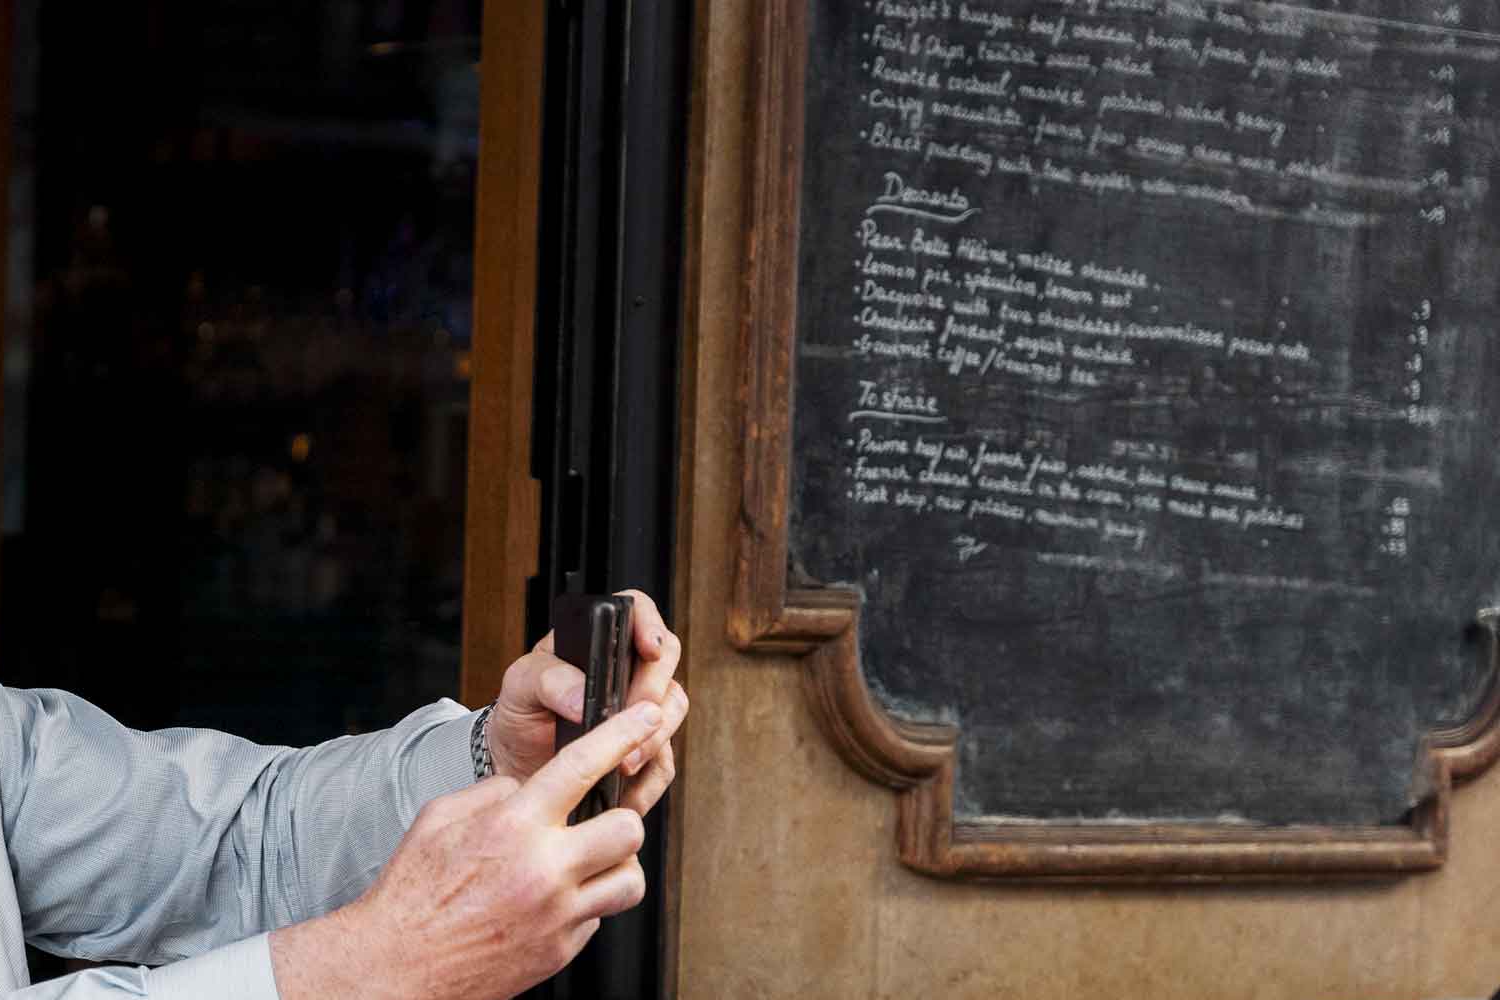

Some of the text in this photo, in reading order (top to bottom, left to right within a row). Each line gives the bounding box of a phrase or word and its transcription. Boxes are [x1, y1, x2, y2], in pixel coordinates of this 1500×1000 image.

[872, 24, 906, 51] Fish
[925, 34, 974, 67] Chips,
[872, 55, 940, 89] Roasted
[870, 121, 922, 152] Black
[924, 142, 993, 177] pudding
[876, 171, 969, 210] Desserts
[860, 218, 906, 250] Pear
[861, 252, 916, 280] Lemon
[953, 297, 991, 317] with
[858, 379, 939, 415] To share
[856, 427, 909, 453] Prime
[1058, 478, 1082, 502] the
